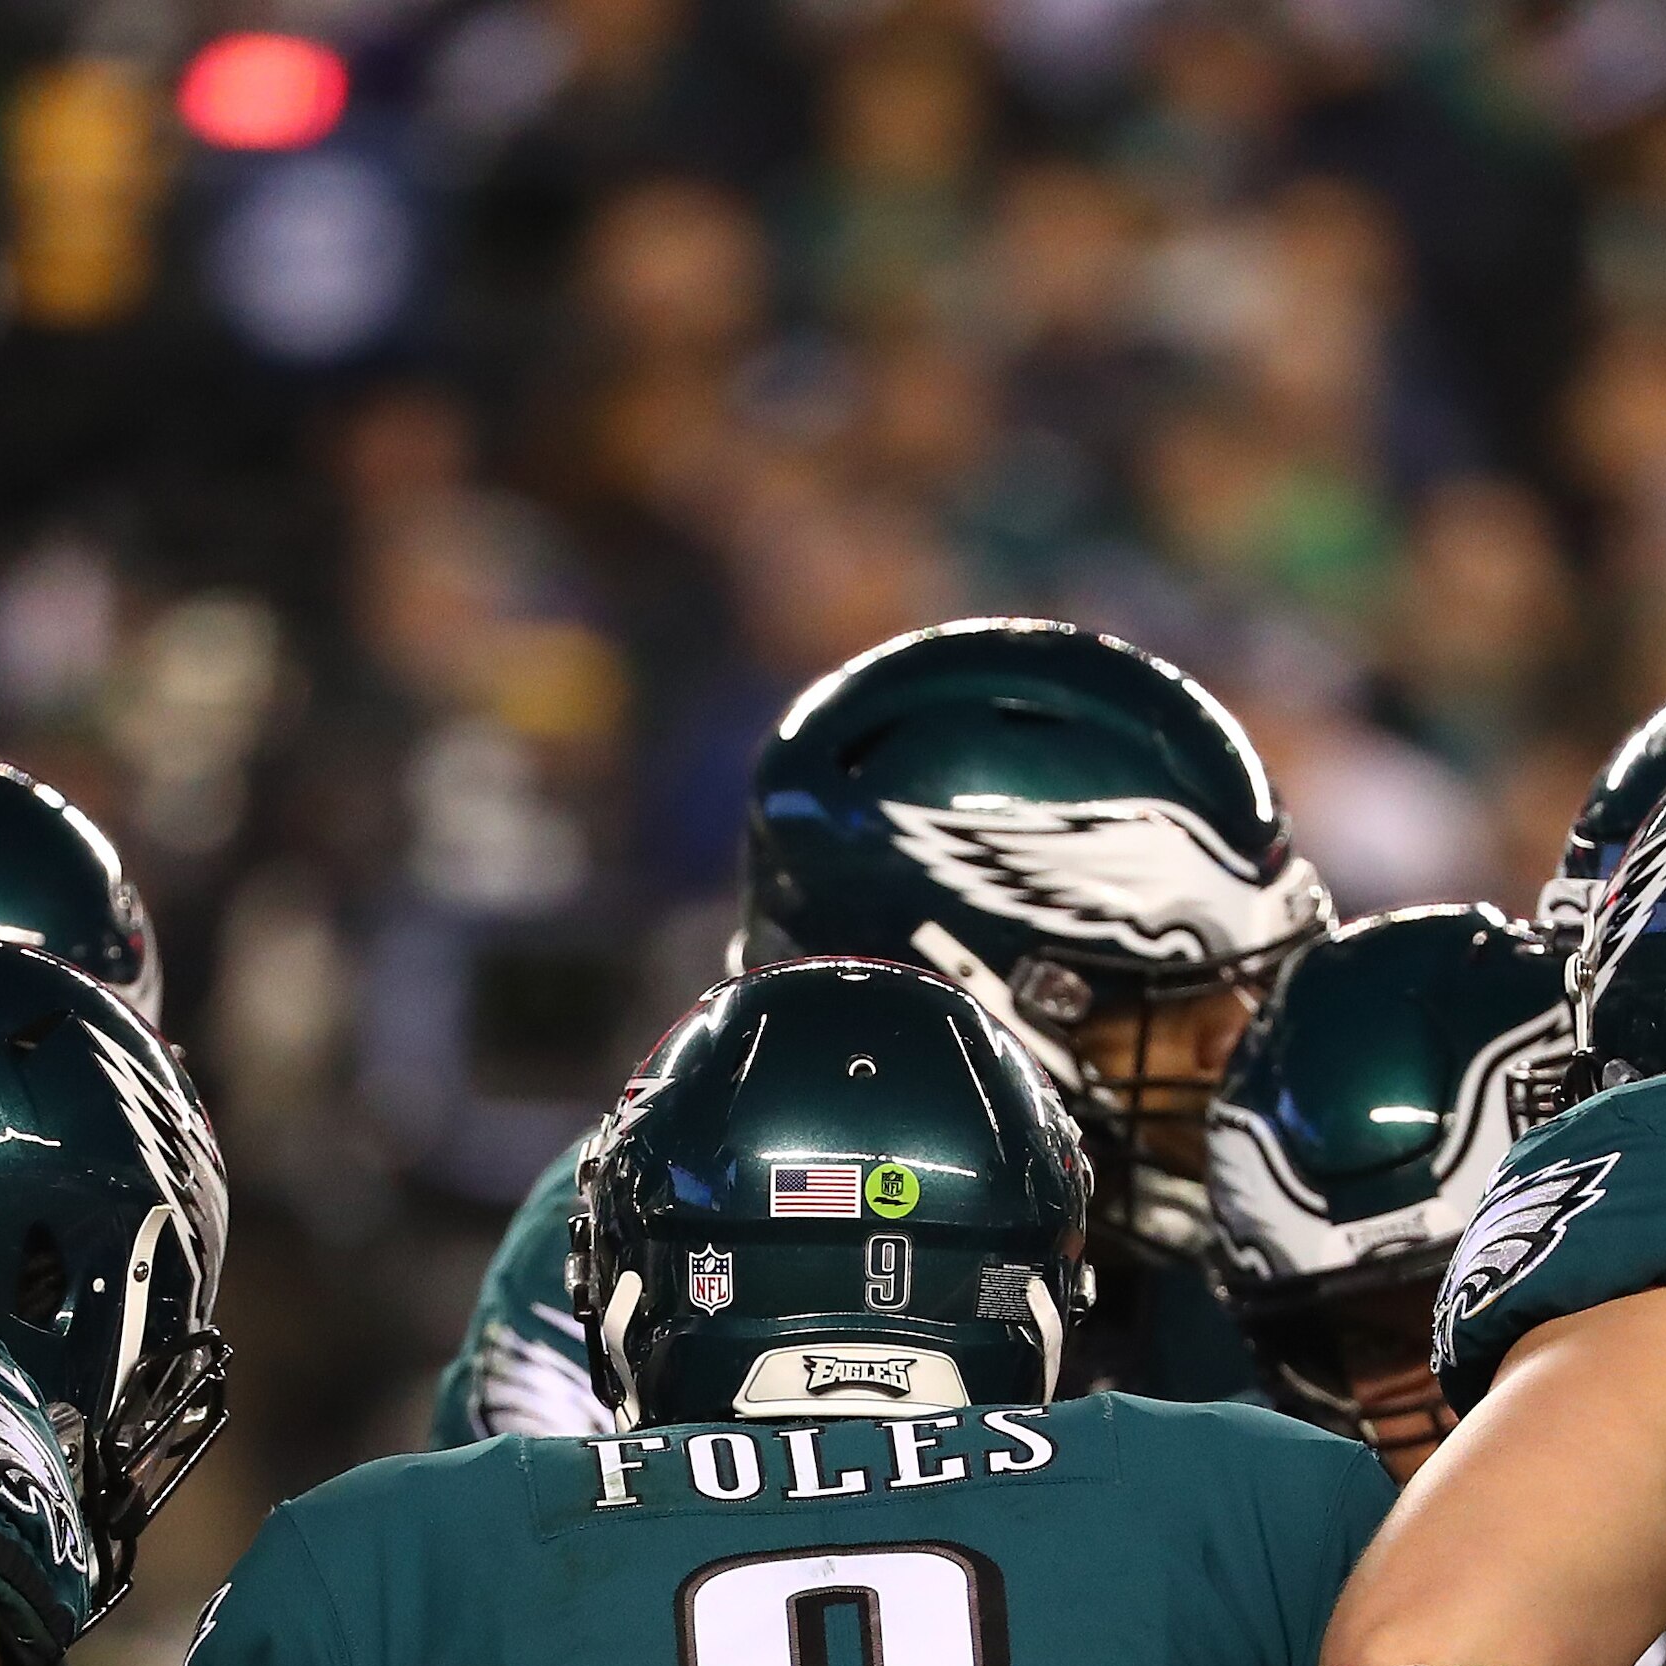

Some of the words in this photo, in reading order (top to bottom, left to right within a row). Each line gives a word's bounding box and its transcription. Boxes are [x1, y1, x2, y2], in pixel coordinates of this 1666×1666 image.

[694, 1276, 728, 1304] NFL
[864, 1232, 913, 1313] 9
[802, 1355, 917, 1399] EAGLES
[585, 1406, 1057, 1511] FOLES
